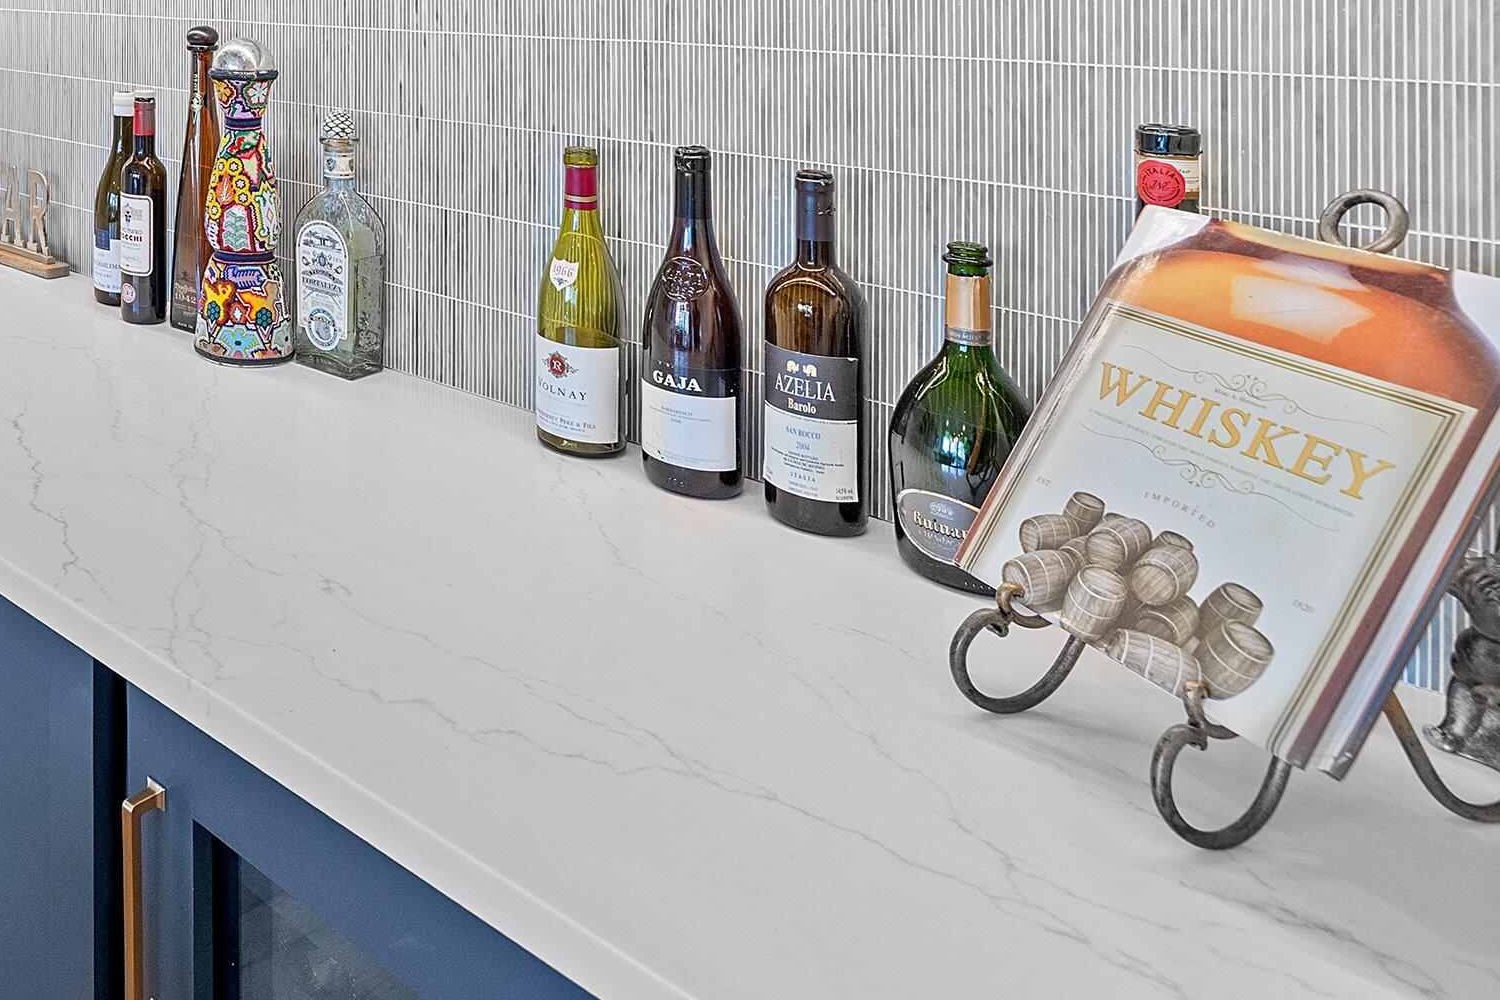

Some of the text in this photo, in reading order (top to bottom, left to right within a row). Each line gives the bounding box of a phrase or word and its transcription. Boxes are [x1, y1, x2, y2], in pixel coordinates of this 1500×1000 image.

[1145, 167, 1176, 179] ITALIA
[553, 264, 574, 277] 1966
[174, 292, 197, 304] 1942
[552, 360, 562, 371] R
[537, 376, 587, 401] VOLNAY
[652, 369, 703, 392] GAJA
[775, 372, 836, 402] AZELIA
[787, 397, 817, 414] Barolo
[798, 429, 821, 441] ROCCO
[1099, 361, 1396, 501] WHISKEY
[790, 471, 816, 483] ITALIA
[1144, 491, 1216, 528] IMPORTED
[913, 510, 968, 540] Ruinar
